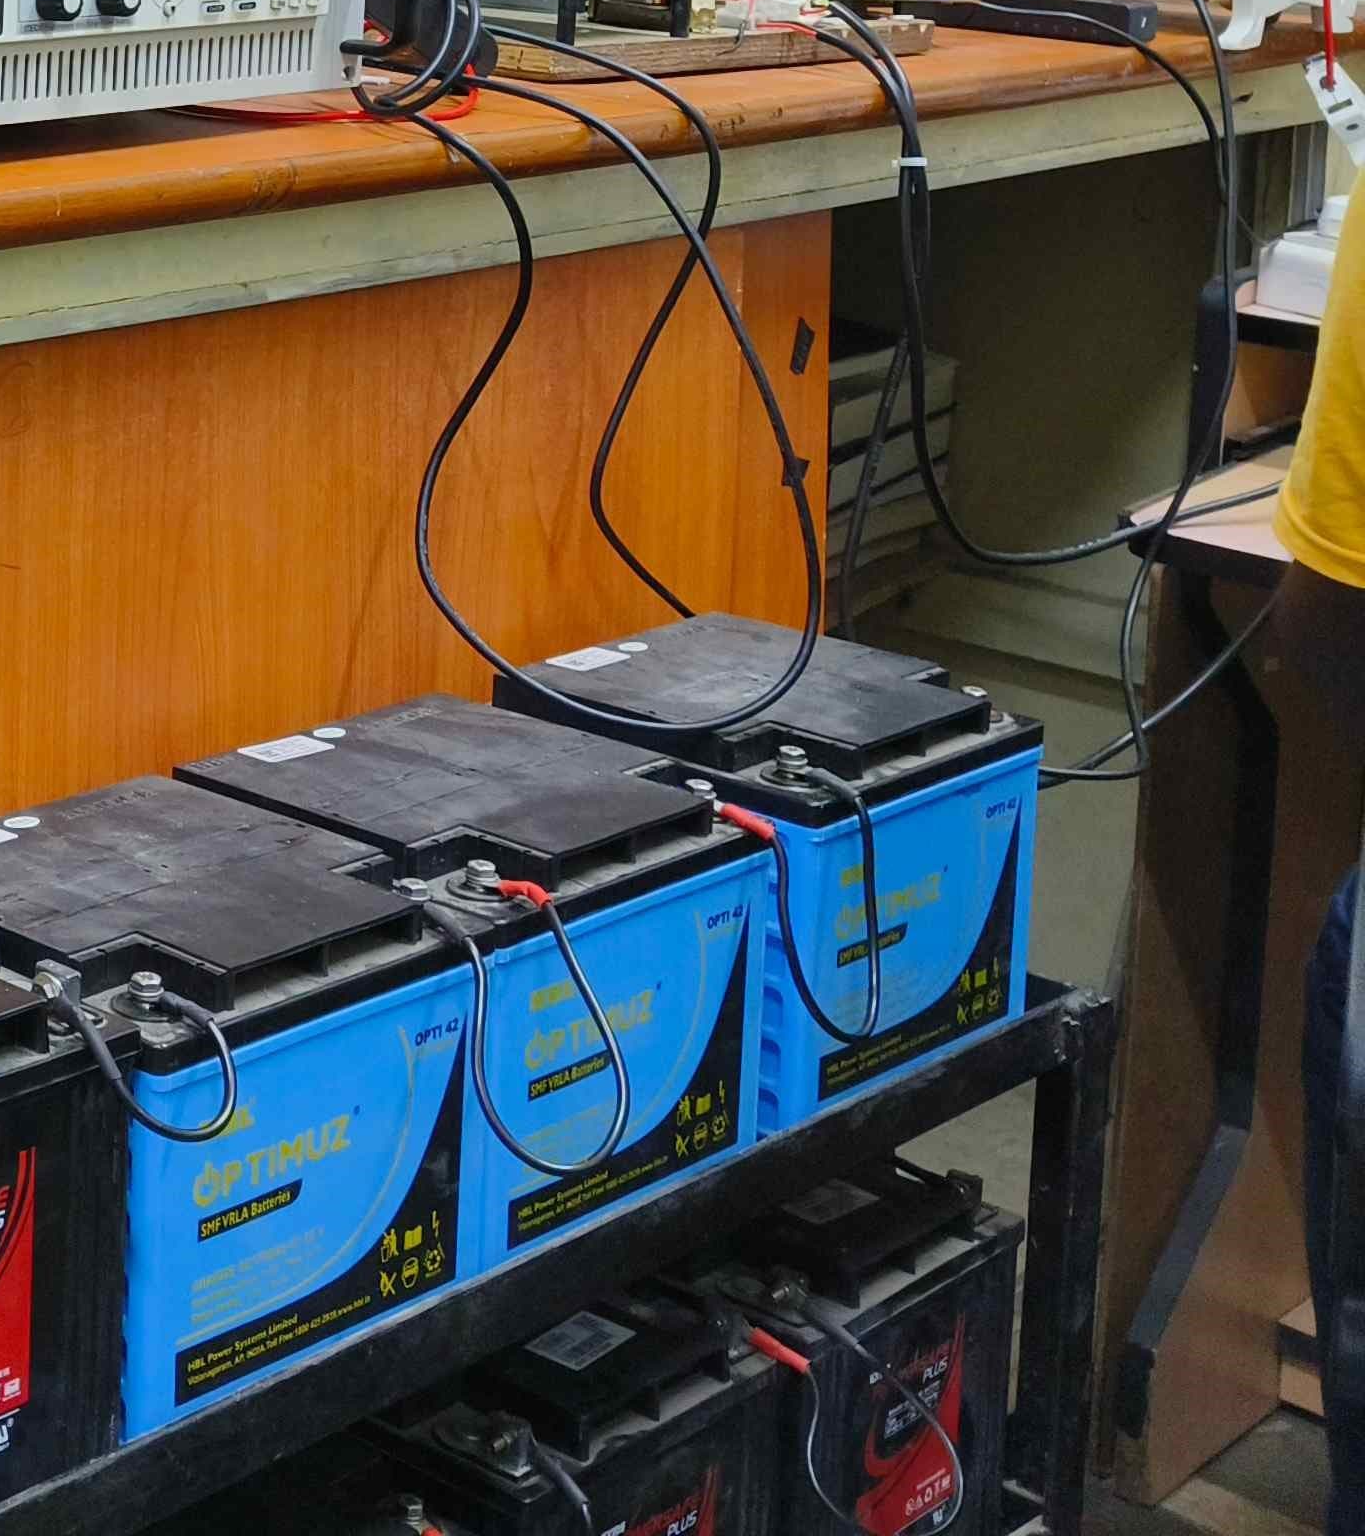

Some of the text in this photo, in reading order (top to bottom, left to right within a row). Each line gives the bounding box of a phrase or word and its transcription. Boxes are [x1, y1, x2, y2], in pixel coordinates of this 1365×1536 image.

[707, 910, 730, 929] OPTI
[415, 1017, 459, 1046] OPTI 42
[193, 1113, 351, 1208] OPTIMUZ
[201, 1190, 291, 1238] SMF VRLA Batteries
[188, 1314, 298, 1373] HBL Power Systems Limited
